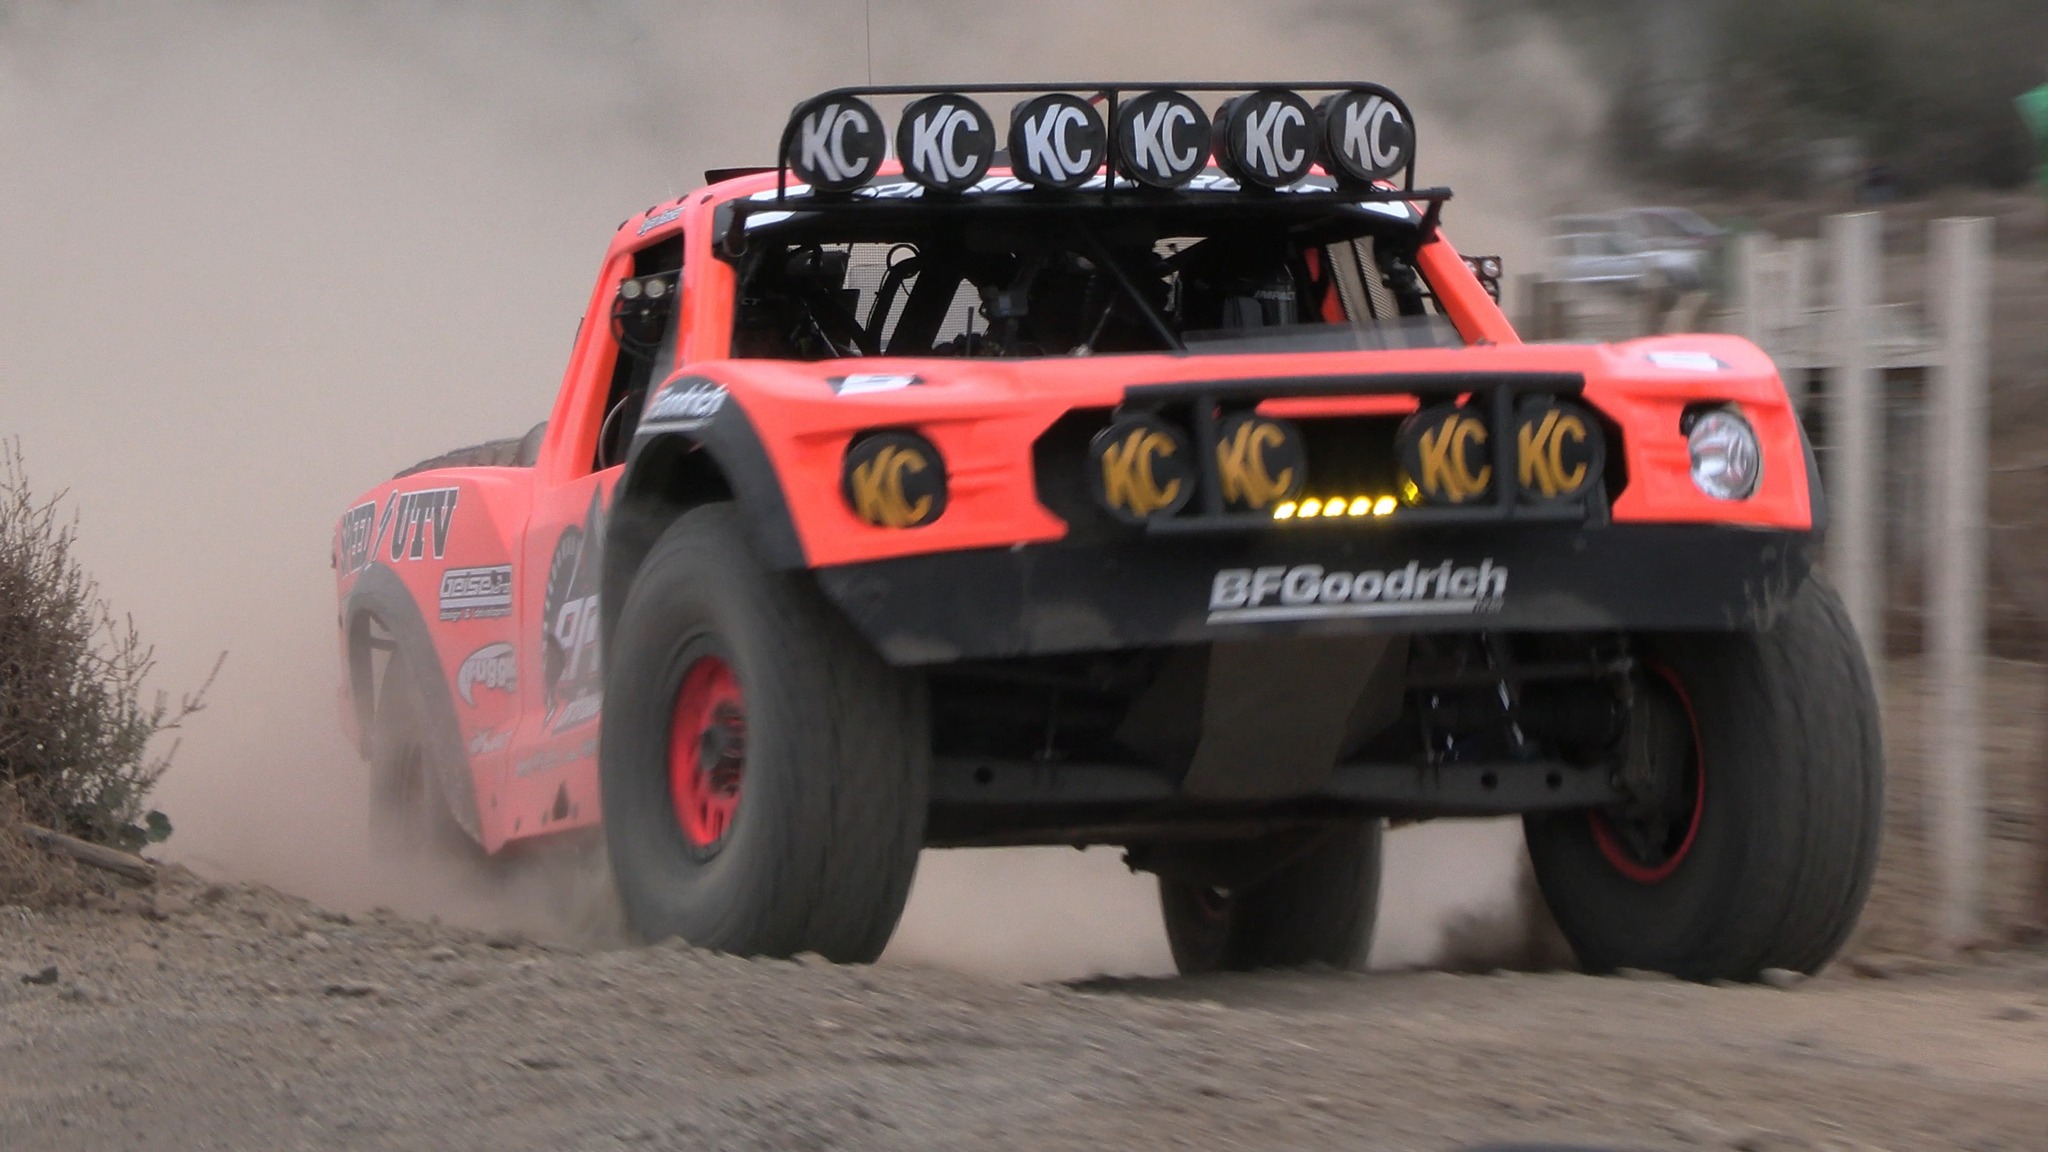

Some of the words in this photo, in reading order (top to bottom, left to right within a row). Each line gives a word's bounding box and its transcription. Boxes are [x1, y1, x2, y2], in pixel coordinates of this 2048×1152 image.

[800, 103, 870, 182] KC
[912, 105, 980, 183] KC
[1024, 103, 1092, 182] KC
[1133, 101, 1198, 178] KC
[1246, 102, 1305, 178] KC
[1343, 96, 1401, 171] KC
[851, 444, 933, 529] KC
[1102, 427, 1182, 518] KC
[1216, 420, 1294, 509] KC
[1418, 413, 1493, 503] KC
[1518, 409, 1587, 499] KC
[1208, 556, 1508, 613] BFGoodrich
